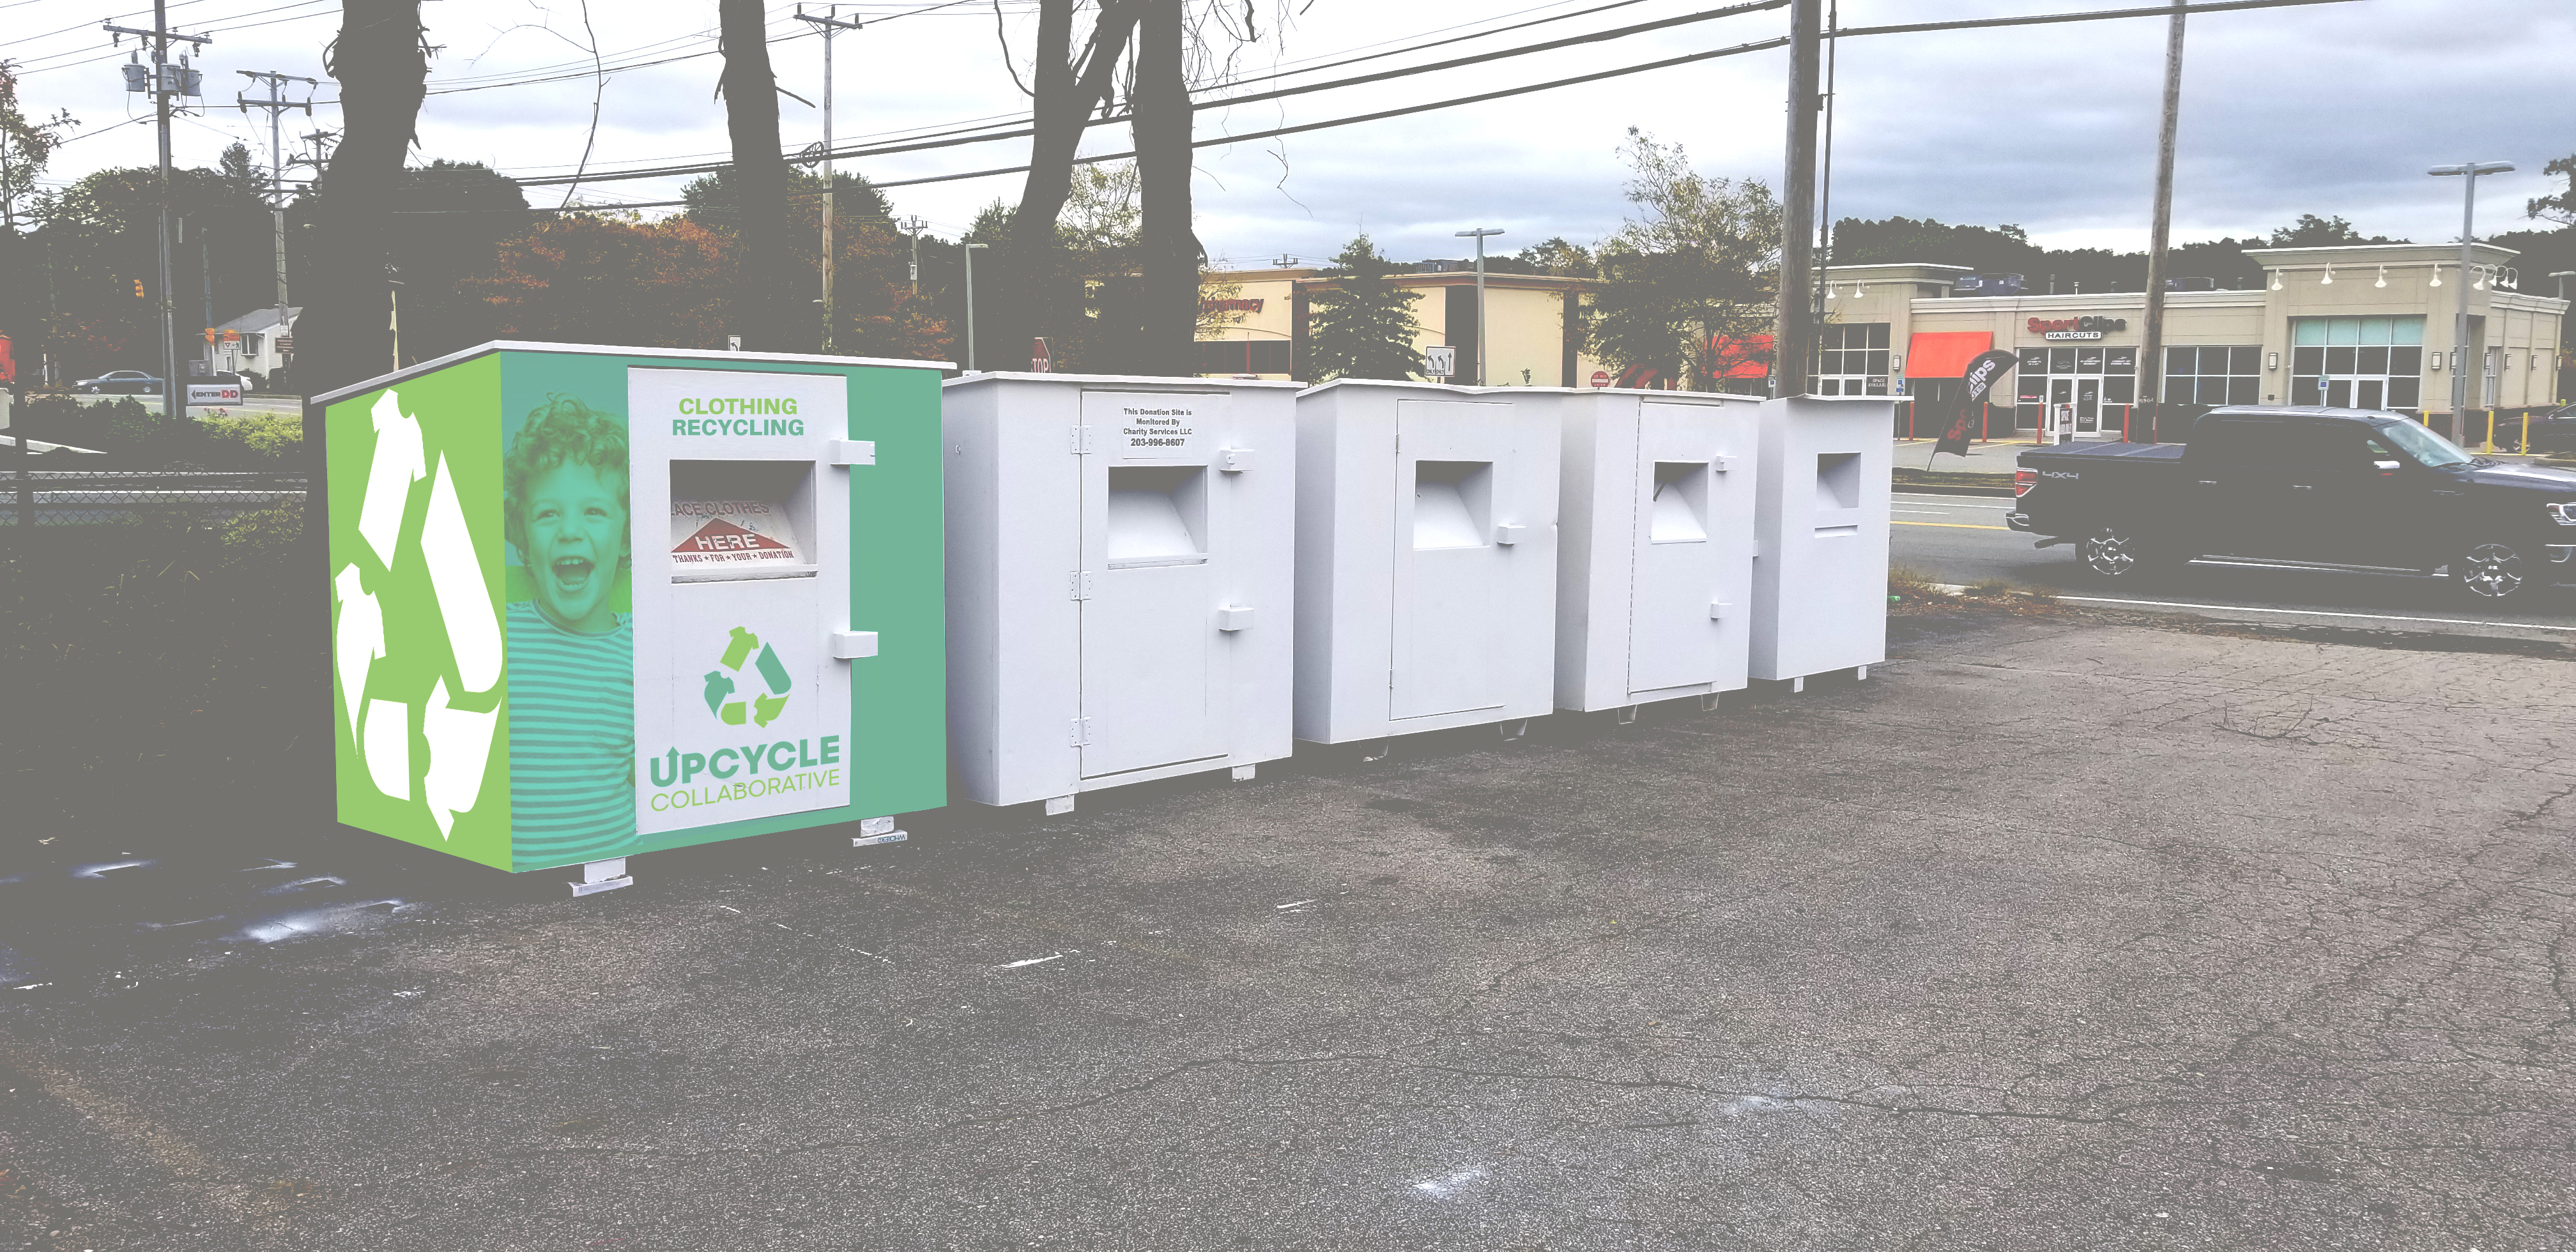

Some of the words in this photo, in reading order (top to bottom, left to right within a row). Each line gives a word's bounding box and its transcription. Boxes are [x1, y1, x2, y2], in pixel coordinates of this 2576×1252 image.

[1031, 358, 1049, 373] TOP
[221, 390, 239, 399] DD
[678, 398, 798, 415] CLOTHING
[672, 419, 804, 436] RECYCLING
[1171, 418, 1180, 427] By
[1123, 427, 1147, 436] Charity
[1130, 438, 1185, 447] 203-996-8607
[704, 500, 770, 516] CLOTHES
[694, 533, 760, 550] HERE
[672, 554, 703, 563] THANKS
[710, 553, 726, 562] FOR
[731, 552, 753, 561] YOUR
[758, 550, 794, 560] DONATION
[650, 735, 839, 788] UPCYCLE
[650, 768, 839, 812] COLLABORATIVE
